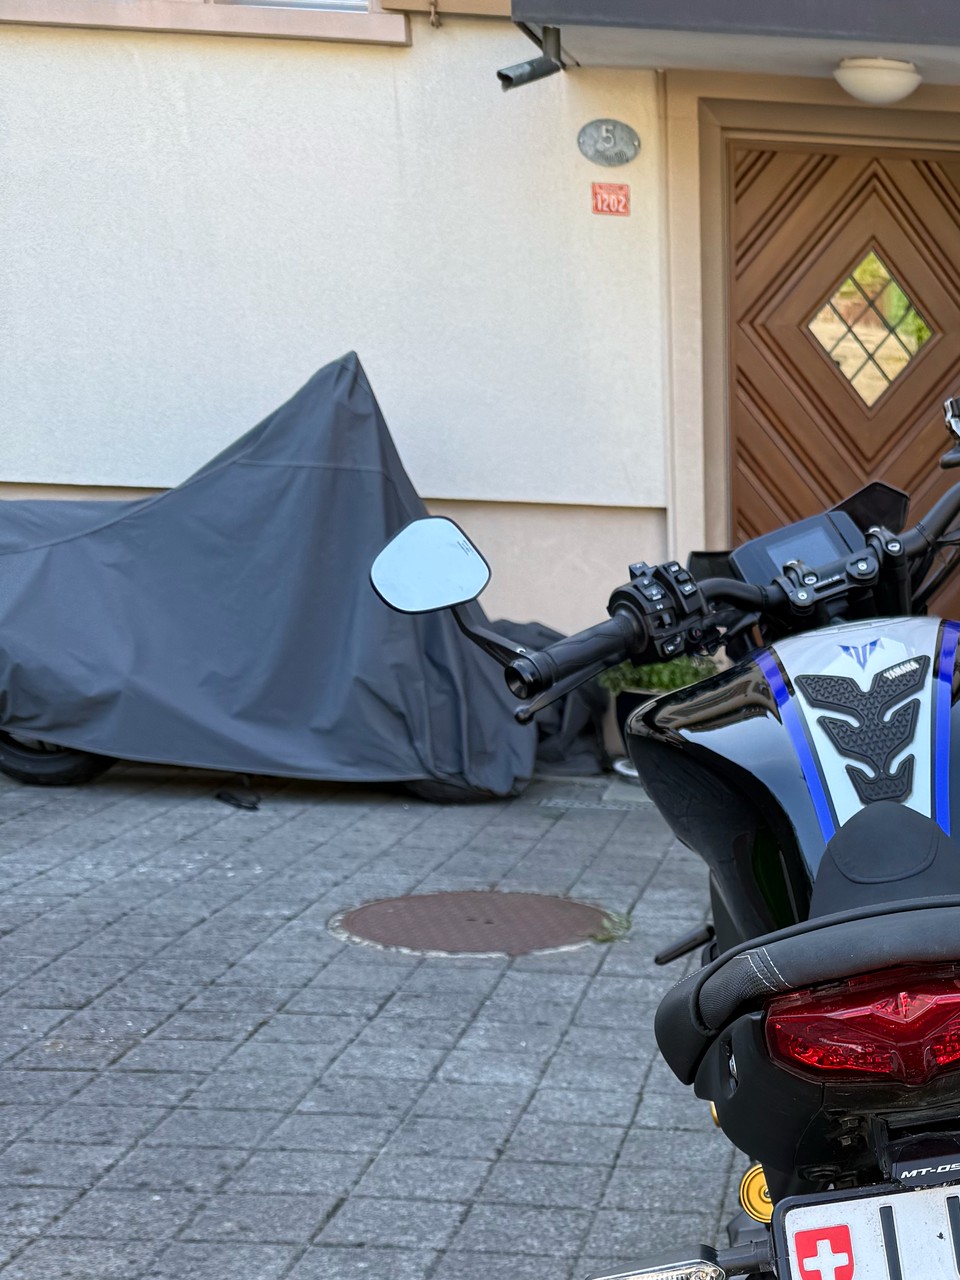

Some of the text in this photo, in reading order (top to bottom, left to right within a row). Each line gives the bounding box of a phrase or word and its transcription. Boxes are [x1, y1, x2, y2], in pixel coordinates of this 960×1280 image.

[601, 125, 615, 147] 5
[595, 193, 627, 213] 1202
[883, 660, 920, 680] YAMAHA
